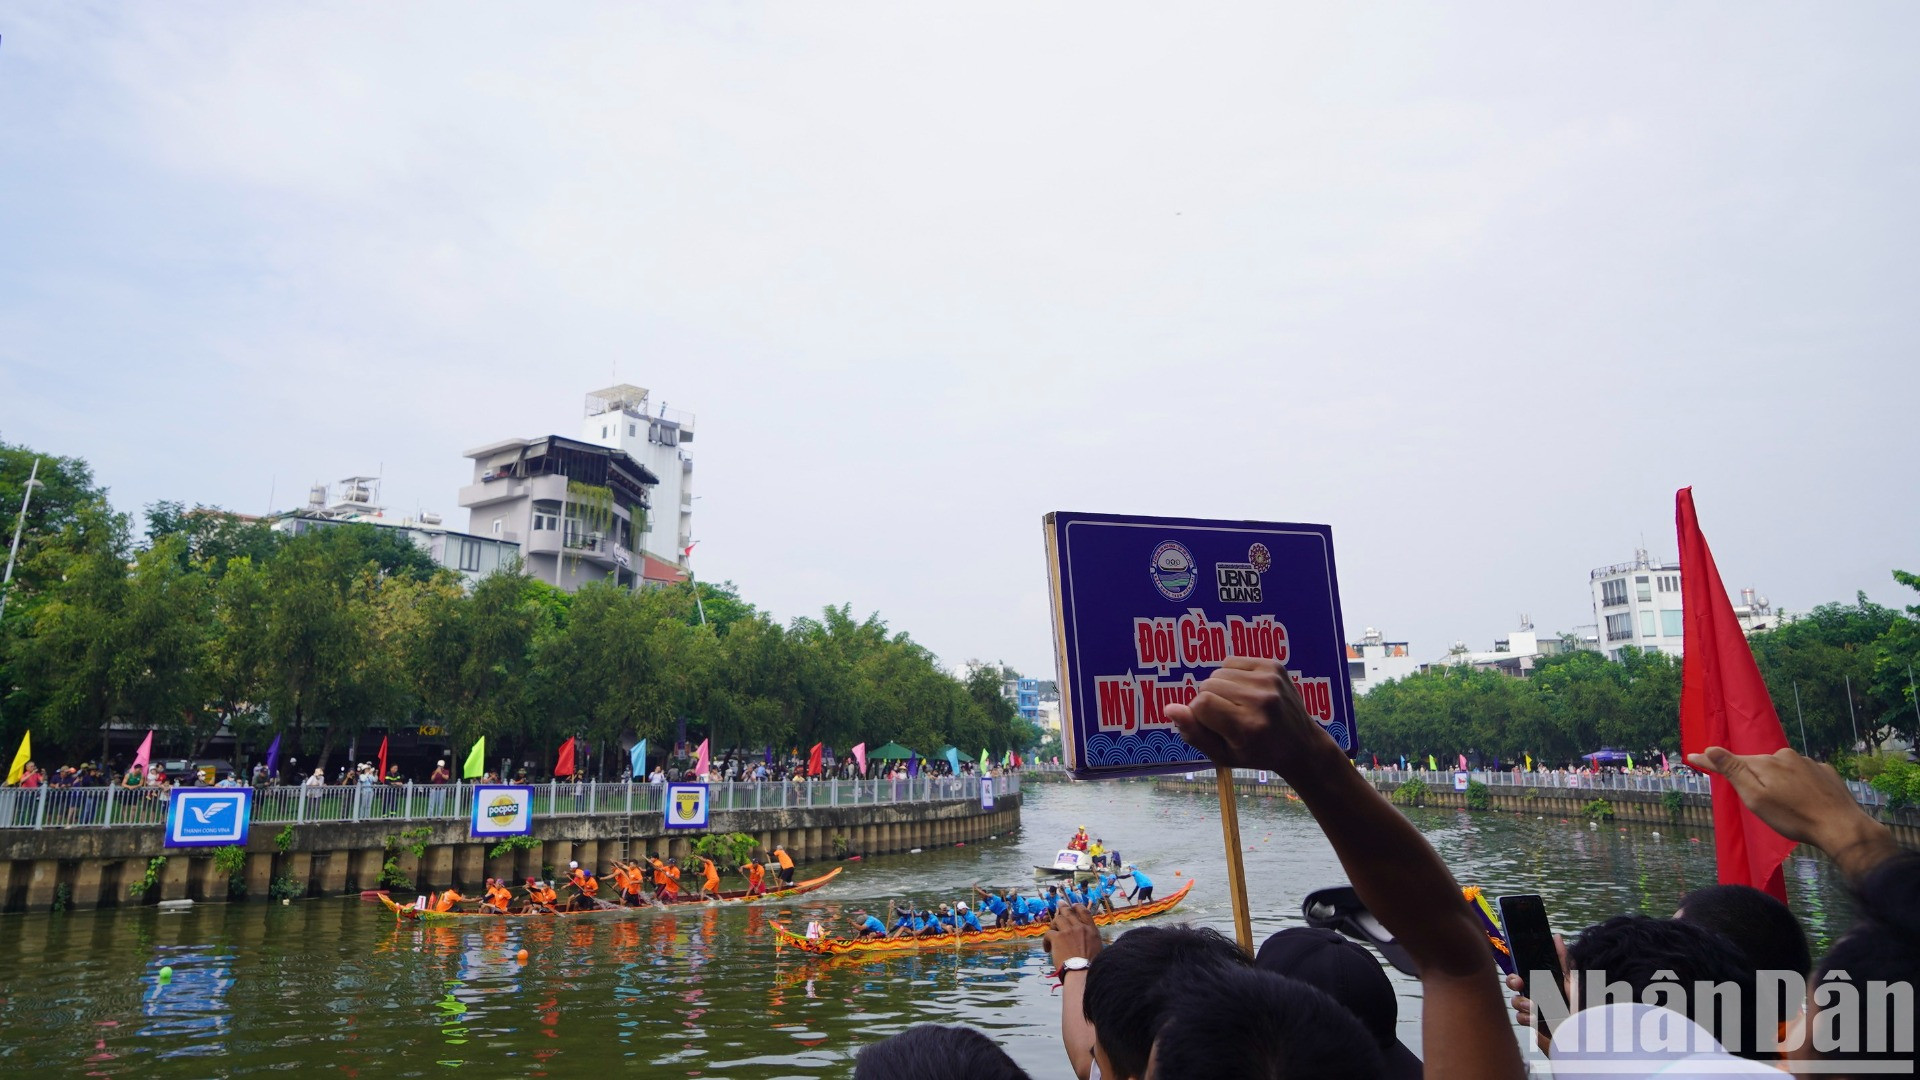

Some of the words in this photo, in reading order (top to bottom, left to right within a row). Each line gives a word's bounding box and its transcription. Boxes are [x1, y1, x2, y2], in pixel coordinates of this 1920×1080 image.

[1217, 569, 1260, 587] UBND
[1138, 622, 1176, 671] Đội
[1181, 613, 1227, 663] Cần
[1230, 619, 1287, 661] Đước
[1099, 680, 1135, 730] Mỹ
